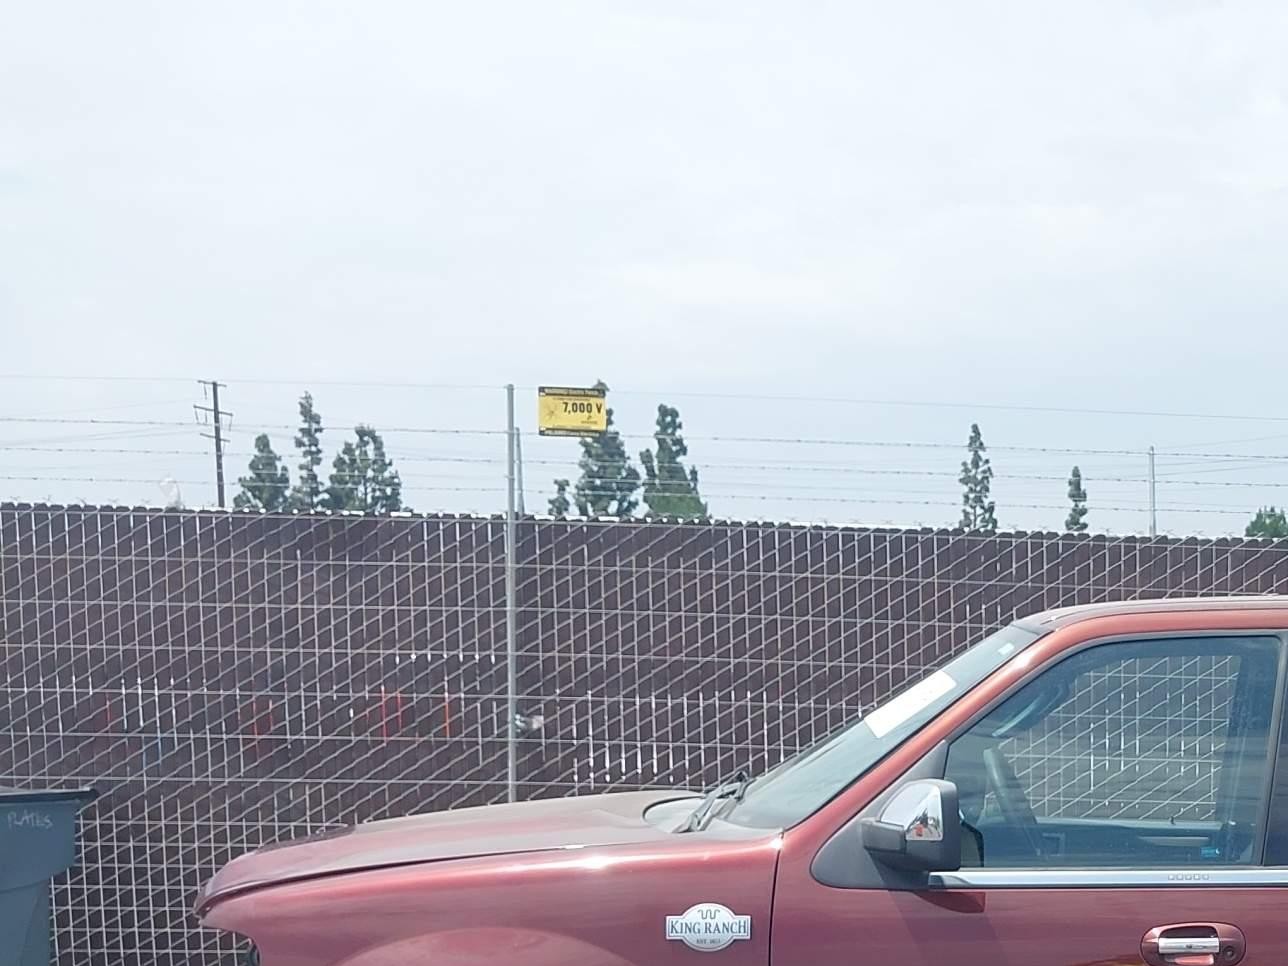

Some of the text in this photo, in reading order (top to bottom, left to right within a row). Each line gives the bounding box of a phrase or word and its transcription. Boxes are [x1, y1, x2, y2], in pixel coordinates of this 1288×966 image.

[562, 402, 602, 415] 7,000 V
[670, 920, 747, 934] KING RANCH
